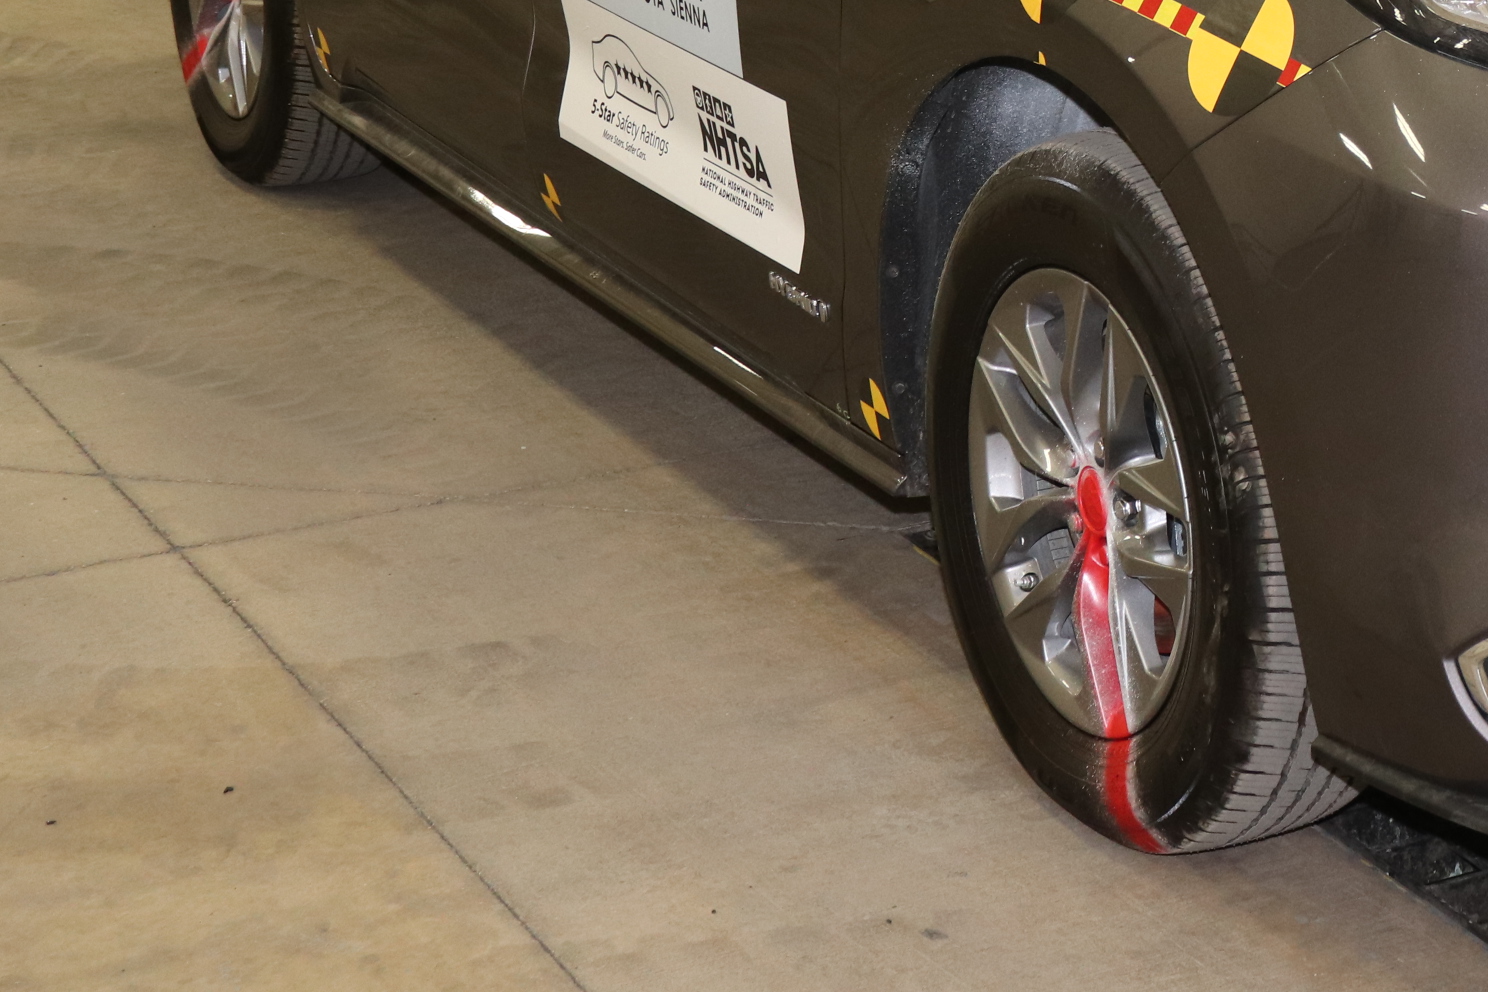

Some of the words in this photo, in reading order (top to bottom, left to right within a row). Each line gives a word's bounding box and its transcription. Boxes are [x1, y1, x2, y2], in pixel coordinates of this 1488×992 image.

[591, 98, 616, 124] 5-Star
[615, 111, 641, 142] Safety
[640, 124, 670, 157] Ratings
[697, 112, 773, 190] NHTSA
[699, 177, 719, 194] SAFETY
[718, 188, 764, 219] ADMINISTRATION
[701, 165, 726, 186] NATIONAL
[727, 179, 752, 201] HIGHWAY
[752, 193, 775, 212] TRAFFIC
